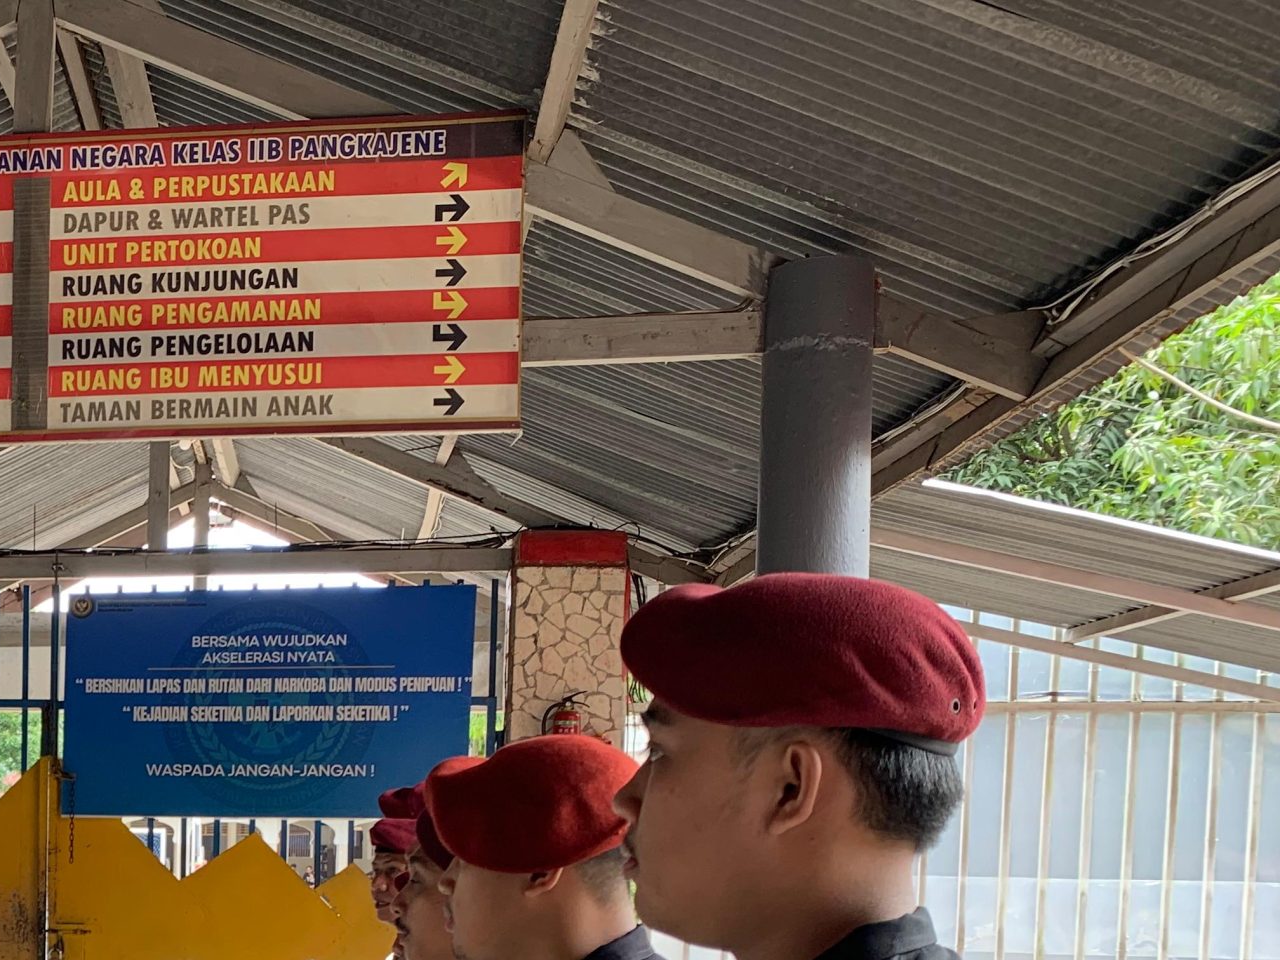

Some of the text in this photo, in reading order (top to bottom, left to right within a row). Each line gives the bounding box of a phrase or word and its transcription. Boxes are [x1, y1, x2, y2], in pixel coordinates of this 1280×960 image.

[70, 140, 167, 171] NEGARA
[171, 136, 242, 166] KELAS
[247, 136, 281, 164] IIB
[289, 129, 448, 161] PANGKAJENE
[62, 170, 336, 203] AULA & PERPUSTAKAAN
[63, 201, 311, 234] DAPUR & WARTEL PAS
[62, 236, 262, 266] UNIT PERTOKOAN
[62, 267, 299, 297] RUANG KUNJUNGAN
[62, 298, 321, 329] RUANG PENGAMANAN
[62, 330, 315, 360] RUANG PENGELOLAAN
[61, 362, 323, 392] RUANG IBU MENYUSUI
[60, 394, 334, 423] TAMAN BERMAIN ANAK
[191, 633, 348, 648] BERSAMA WUJUDKAN
[201, 650, 336, 664] AKSELERASI NYATA
[85, 678, 144, 693] BERSIHKAN
[146, 678, 181, 693] LAPAS
[183, 678, 206, 693] DAN
[208, 678, 244, 693] RUTAN
[246, 678, 272, 693] DARI
[274, 677, 326, 692] NARKOBA
[329, 677, 353, 692] DAN
[355, 677, 398, 692] MODUS
[399, 677, 455, 692] PENIPUAN
[133, 706, 188, 722] KEJADIAN
[191, 706, 243, 722] SEKETIKA
[246, 706, 270, 722] DAN
[272, 706, 334, 722] LAPORKAN
[336, 706, 391, 721] SEKETIKA
[145, 763, 225, 778] WASPADA
[228, 763, 366, 778] JANGAN-JANGAN
